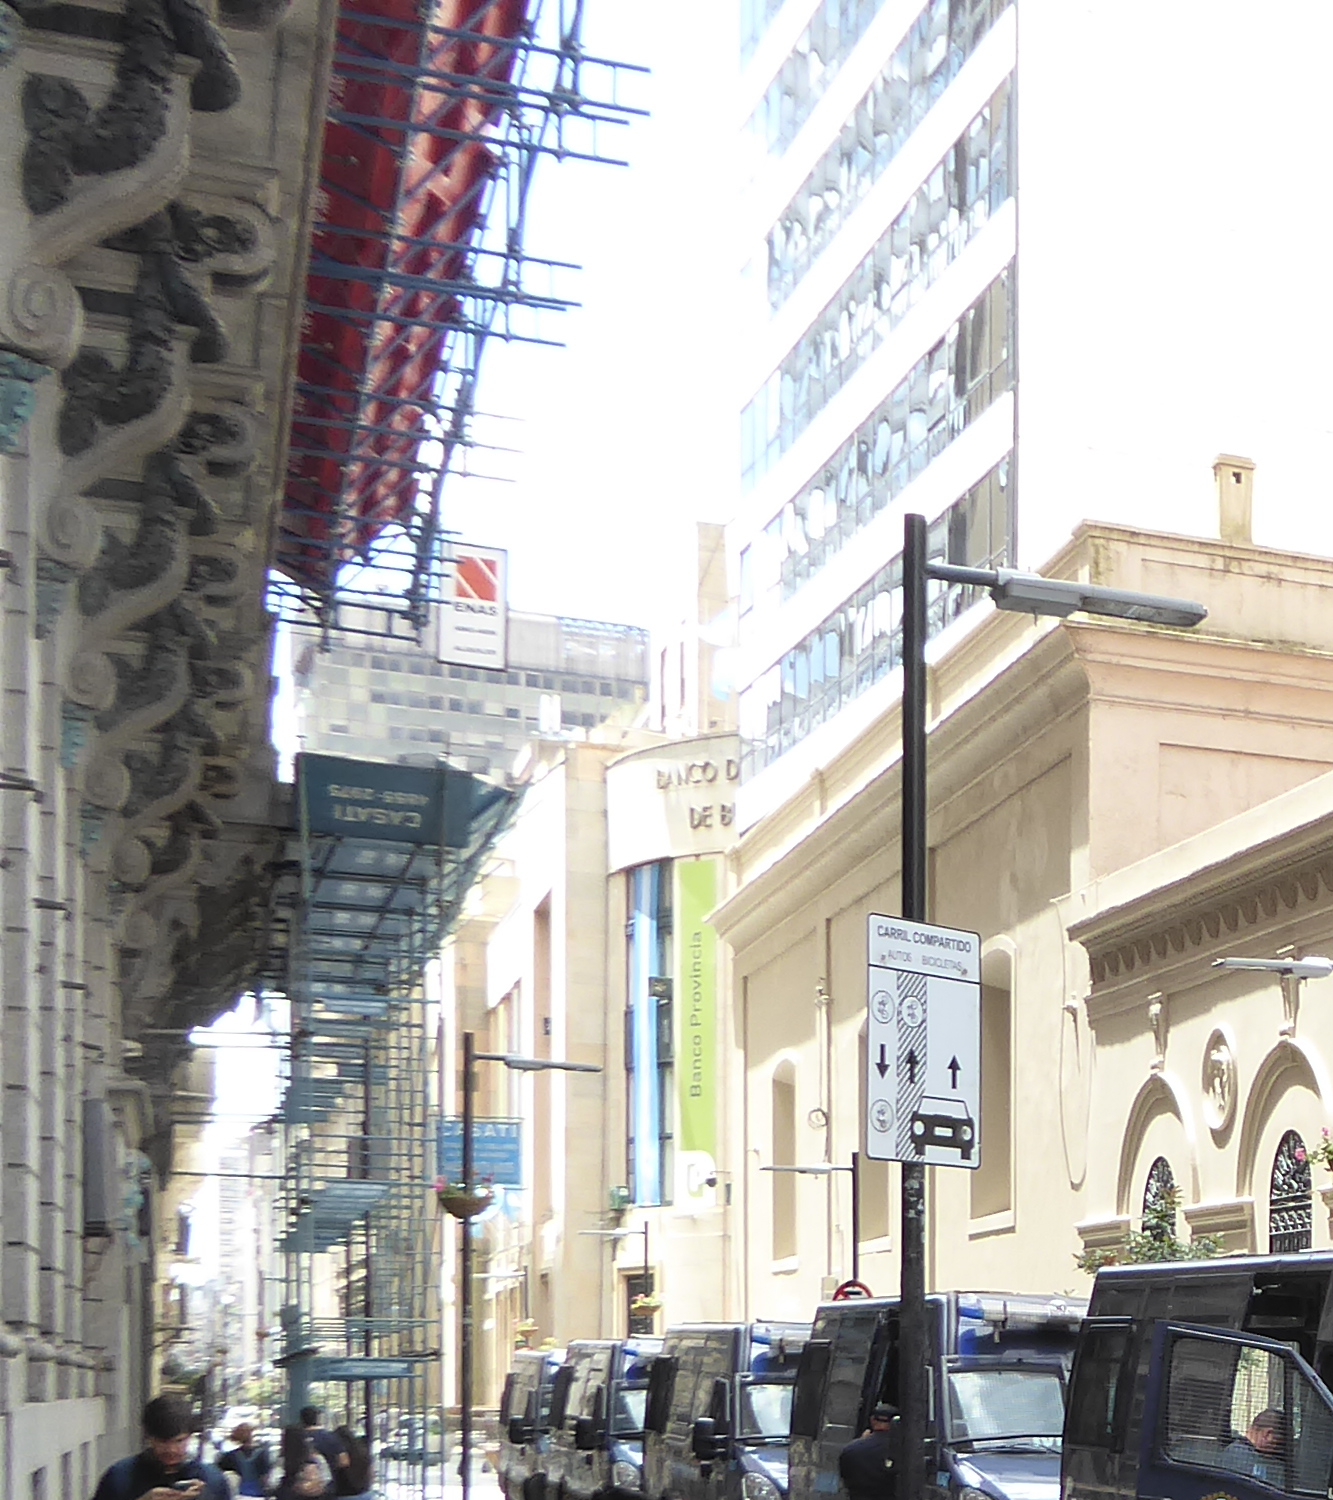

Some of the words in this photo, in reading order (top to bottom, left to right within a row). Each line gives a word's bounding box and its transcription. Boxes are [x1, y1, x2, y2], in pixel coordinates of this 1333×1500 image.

[333, 804, 422, 828] CASATI
[690, 805, 713, 829] DE
[877, 924, 911, 943] CARRIL
[913, 931, 972, 953] COMPARTIDO
[888, 949, 912, 963] AUTOS
[921, 955, 963, 971] BICICLETAS
[689, 931, 702, 1027] Provincia
[690, 1035, 702, 1097] Banco
